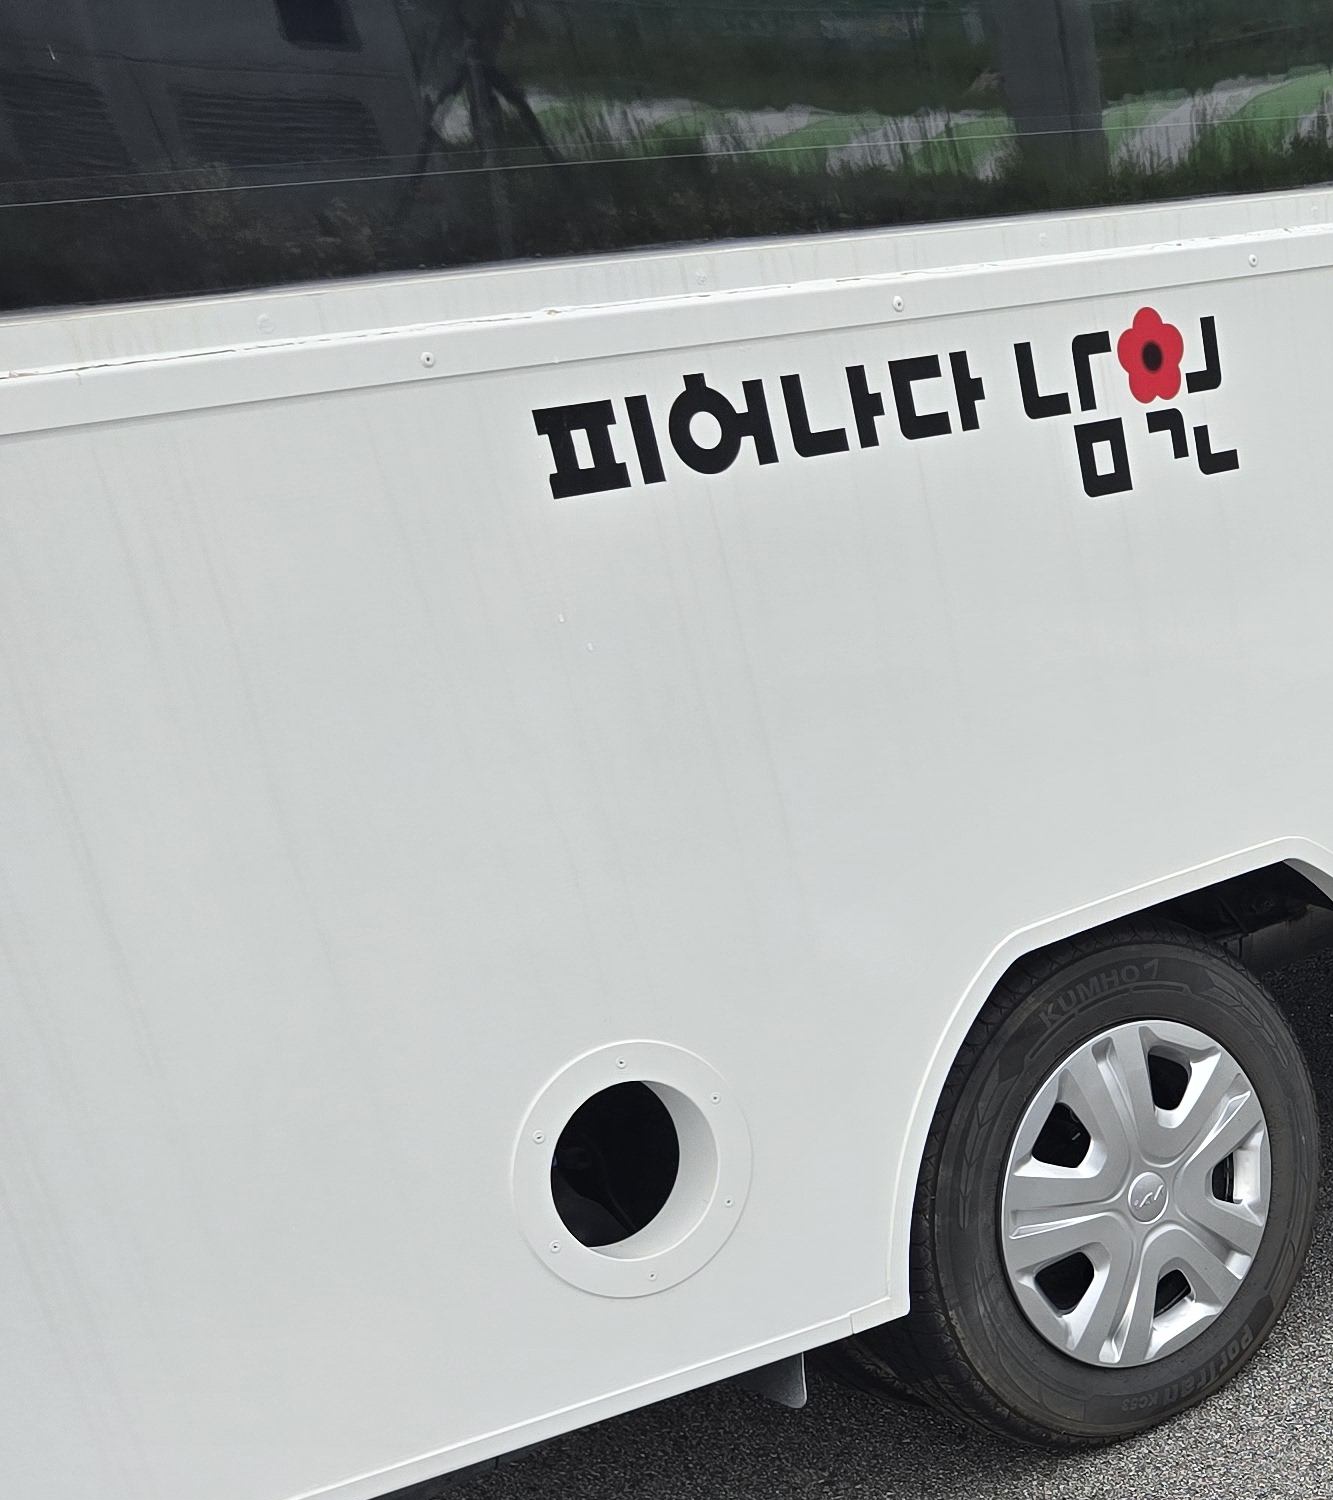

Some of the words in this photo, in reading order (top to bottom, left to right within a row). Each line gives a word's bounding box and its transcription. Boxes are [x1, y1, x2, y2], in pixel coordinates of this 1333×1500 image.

[532, 349, 986, 500] 피어나다
[1038, 964, 1140, 1029] KUMHO
[1121, 1391, 1159, 1411] KC53
